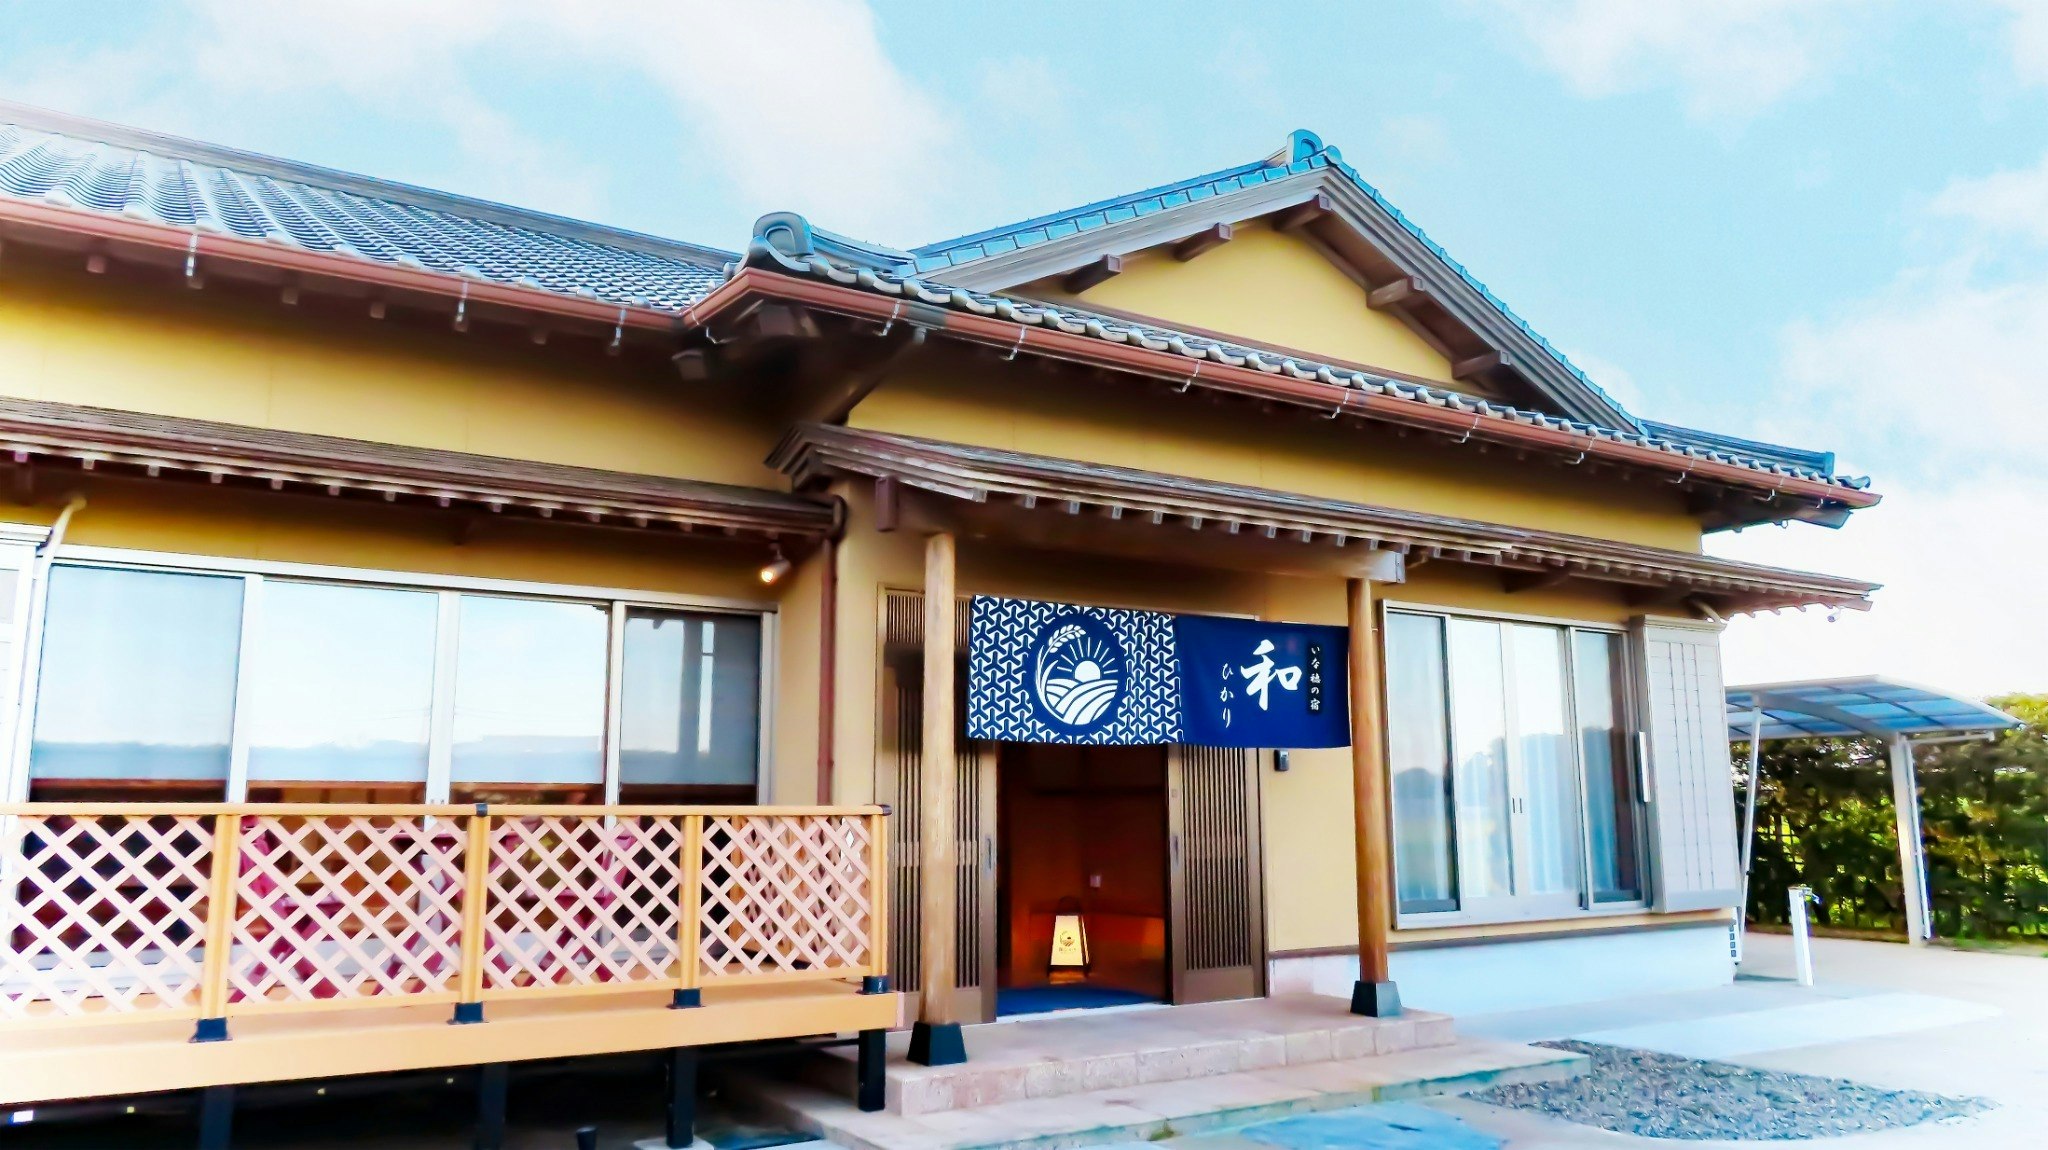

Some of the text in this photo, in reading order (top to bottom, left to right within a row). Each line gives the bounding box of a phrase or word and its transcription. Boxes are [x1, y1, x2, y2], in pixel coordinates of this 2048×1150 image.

[1220, 663, 1234, 728] ひかり
[1240, 639, 1303, 711] 和
[1310, 646, 1322, 710] いな穂の宿
